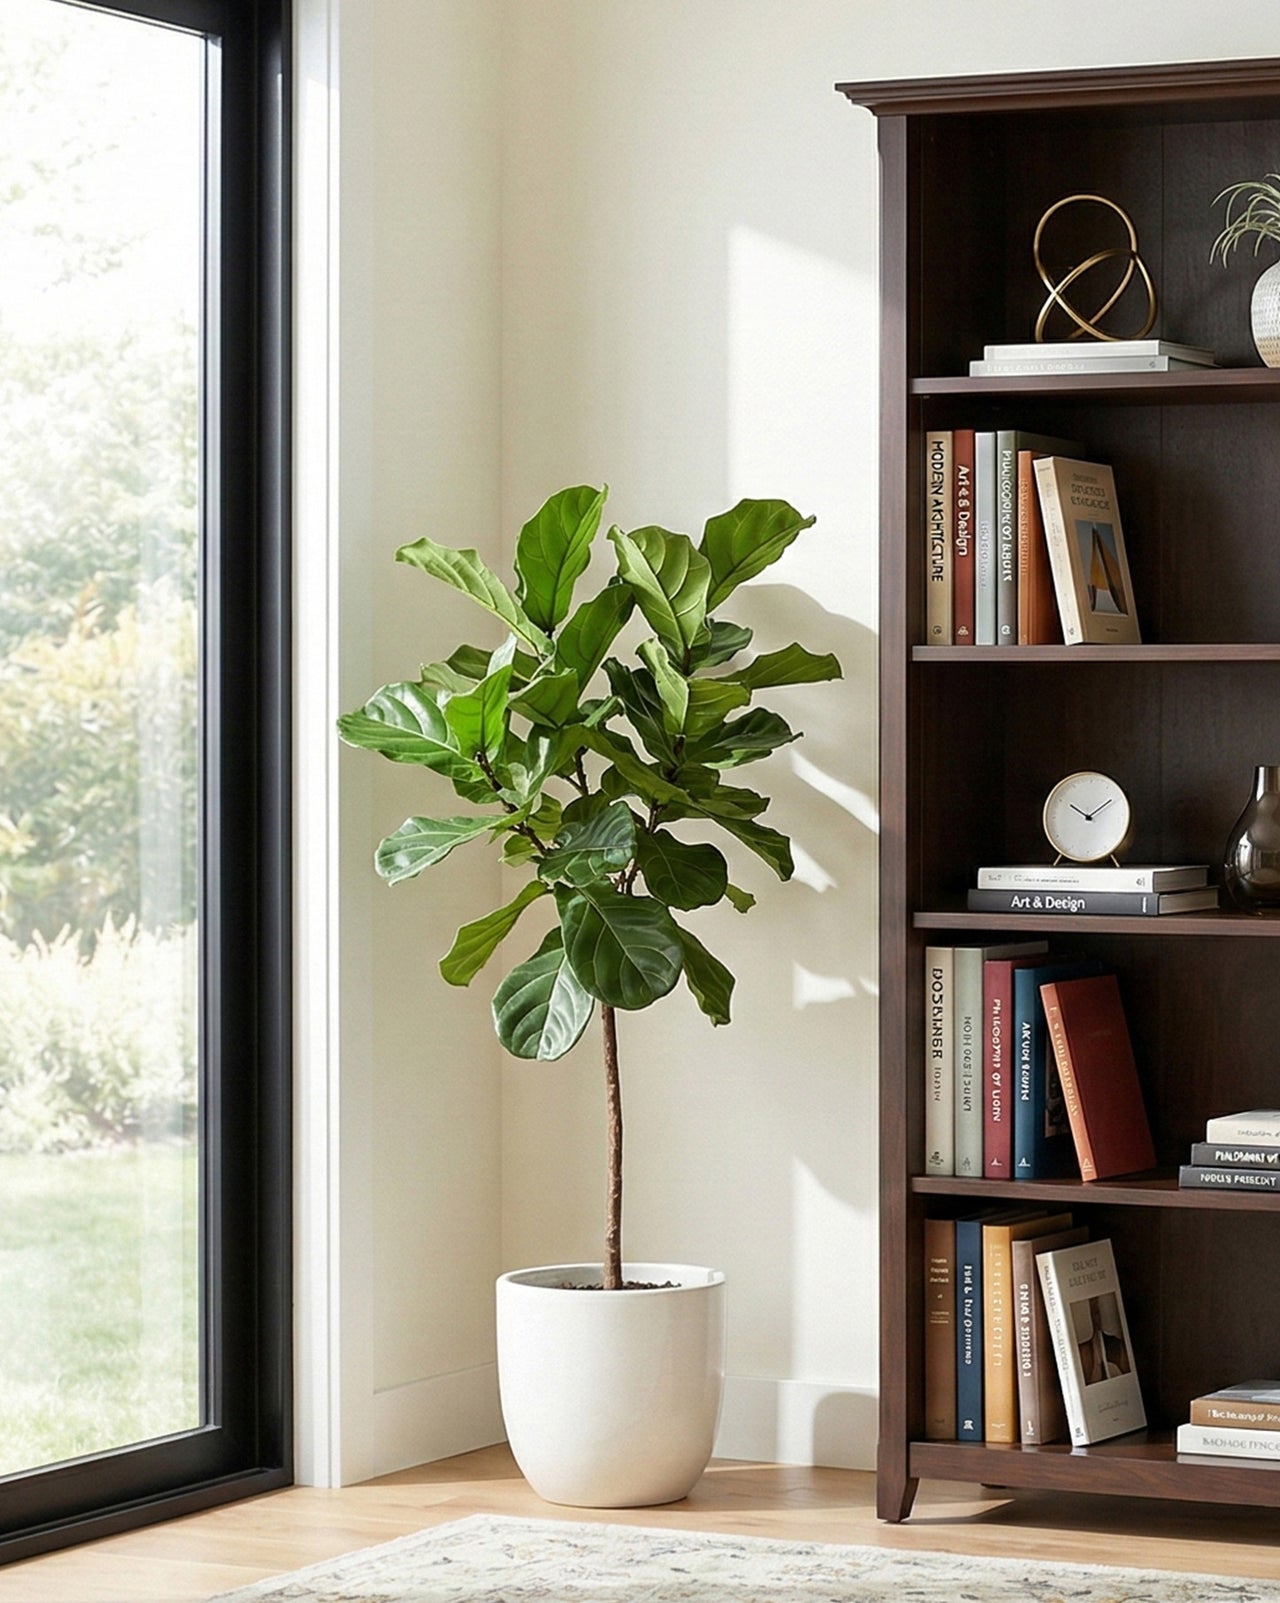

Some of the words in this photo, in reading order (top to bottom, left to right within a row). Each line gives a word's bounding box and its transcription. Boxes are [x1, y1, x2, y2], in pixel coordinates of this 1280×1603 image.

[931, 440, 945, 496] MODERN
[1010, 895, 1031, 909] Art
[1033, 896, 1044, 909] &
